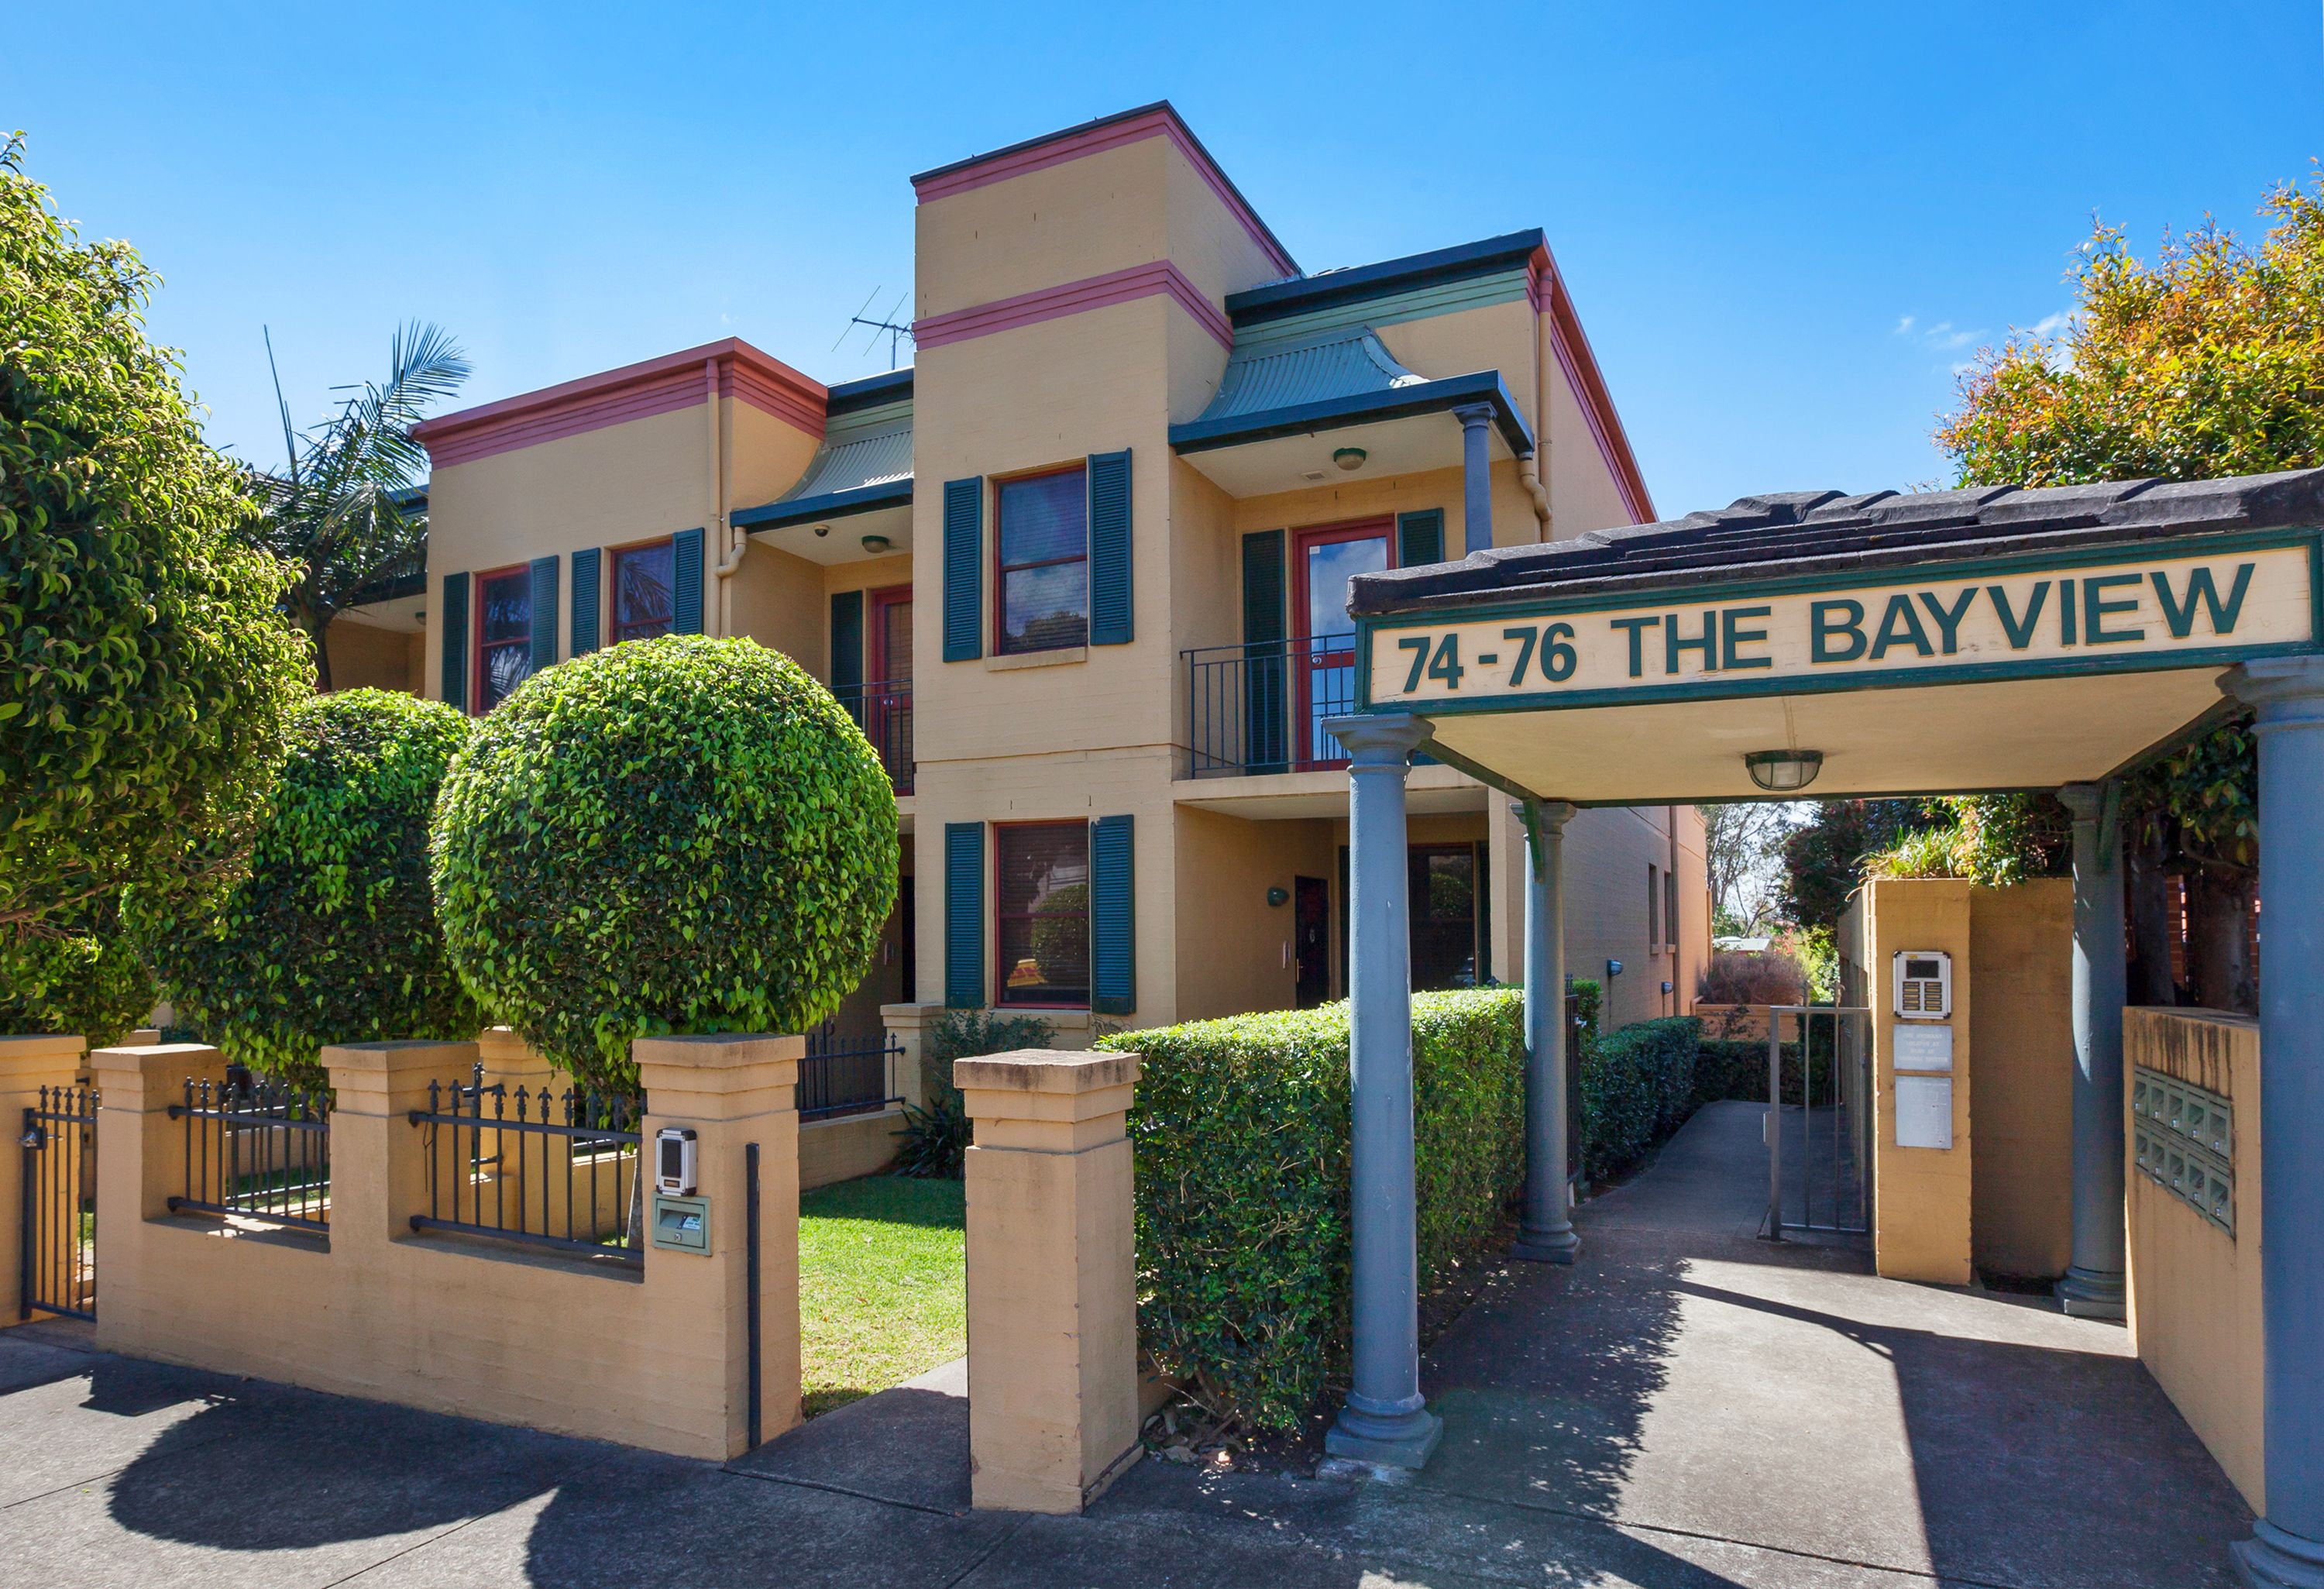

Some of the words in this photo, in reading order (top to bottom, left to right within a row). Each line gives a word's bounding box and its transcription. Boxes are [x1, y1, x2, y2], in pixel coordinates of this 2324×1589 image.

[1397, 622, 1577, 693] 74-76
[1611, 606, 1772, 679] THE
[1810, 562, 2256, 665] BAYVIEW
